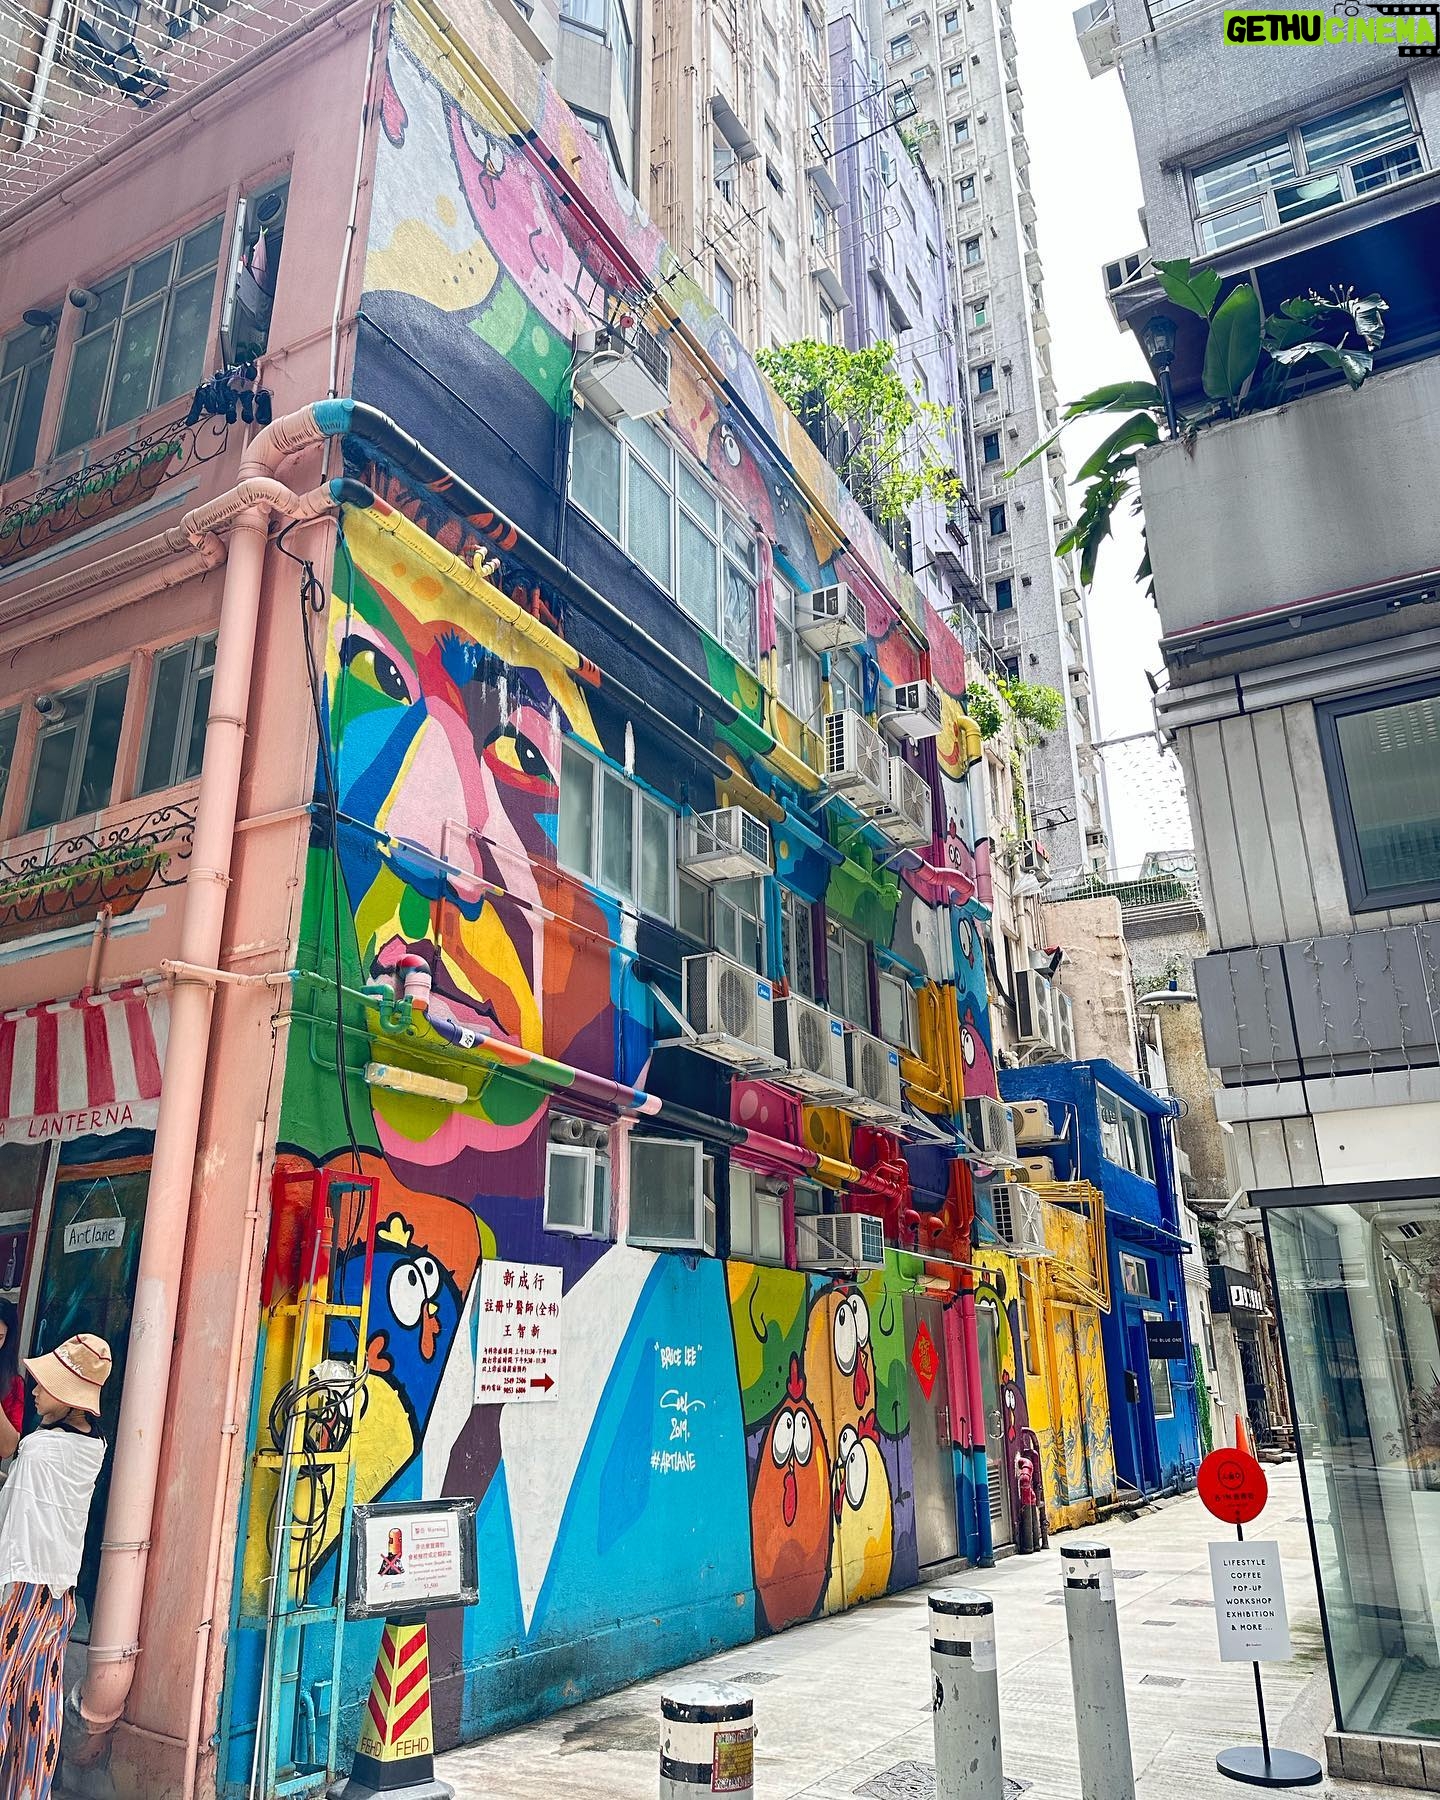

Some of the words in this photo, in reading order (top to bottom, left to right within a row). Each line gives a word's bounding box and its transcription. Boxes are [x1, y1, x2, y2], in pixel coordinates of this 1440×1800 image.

[28, 1104, 133, 1138] LANTERNA
[68, 1225, 116, 1246] Artlane
[503, 1268, 545, 1291] 新成行
[1226, 1610, 1275, 1618] EXHIBITION
[360, 1737, 382, 1757] FEHD
[396, 1737, 429, 1757] FEHD
